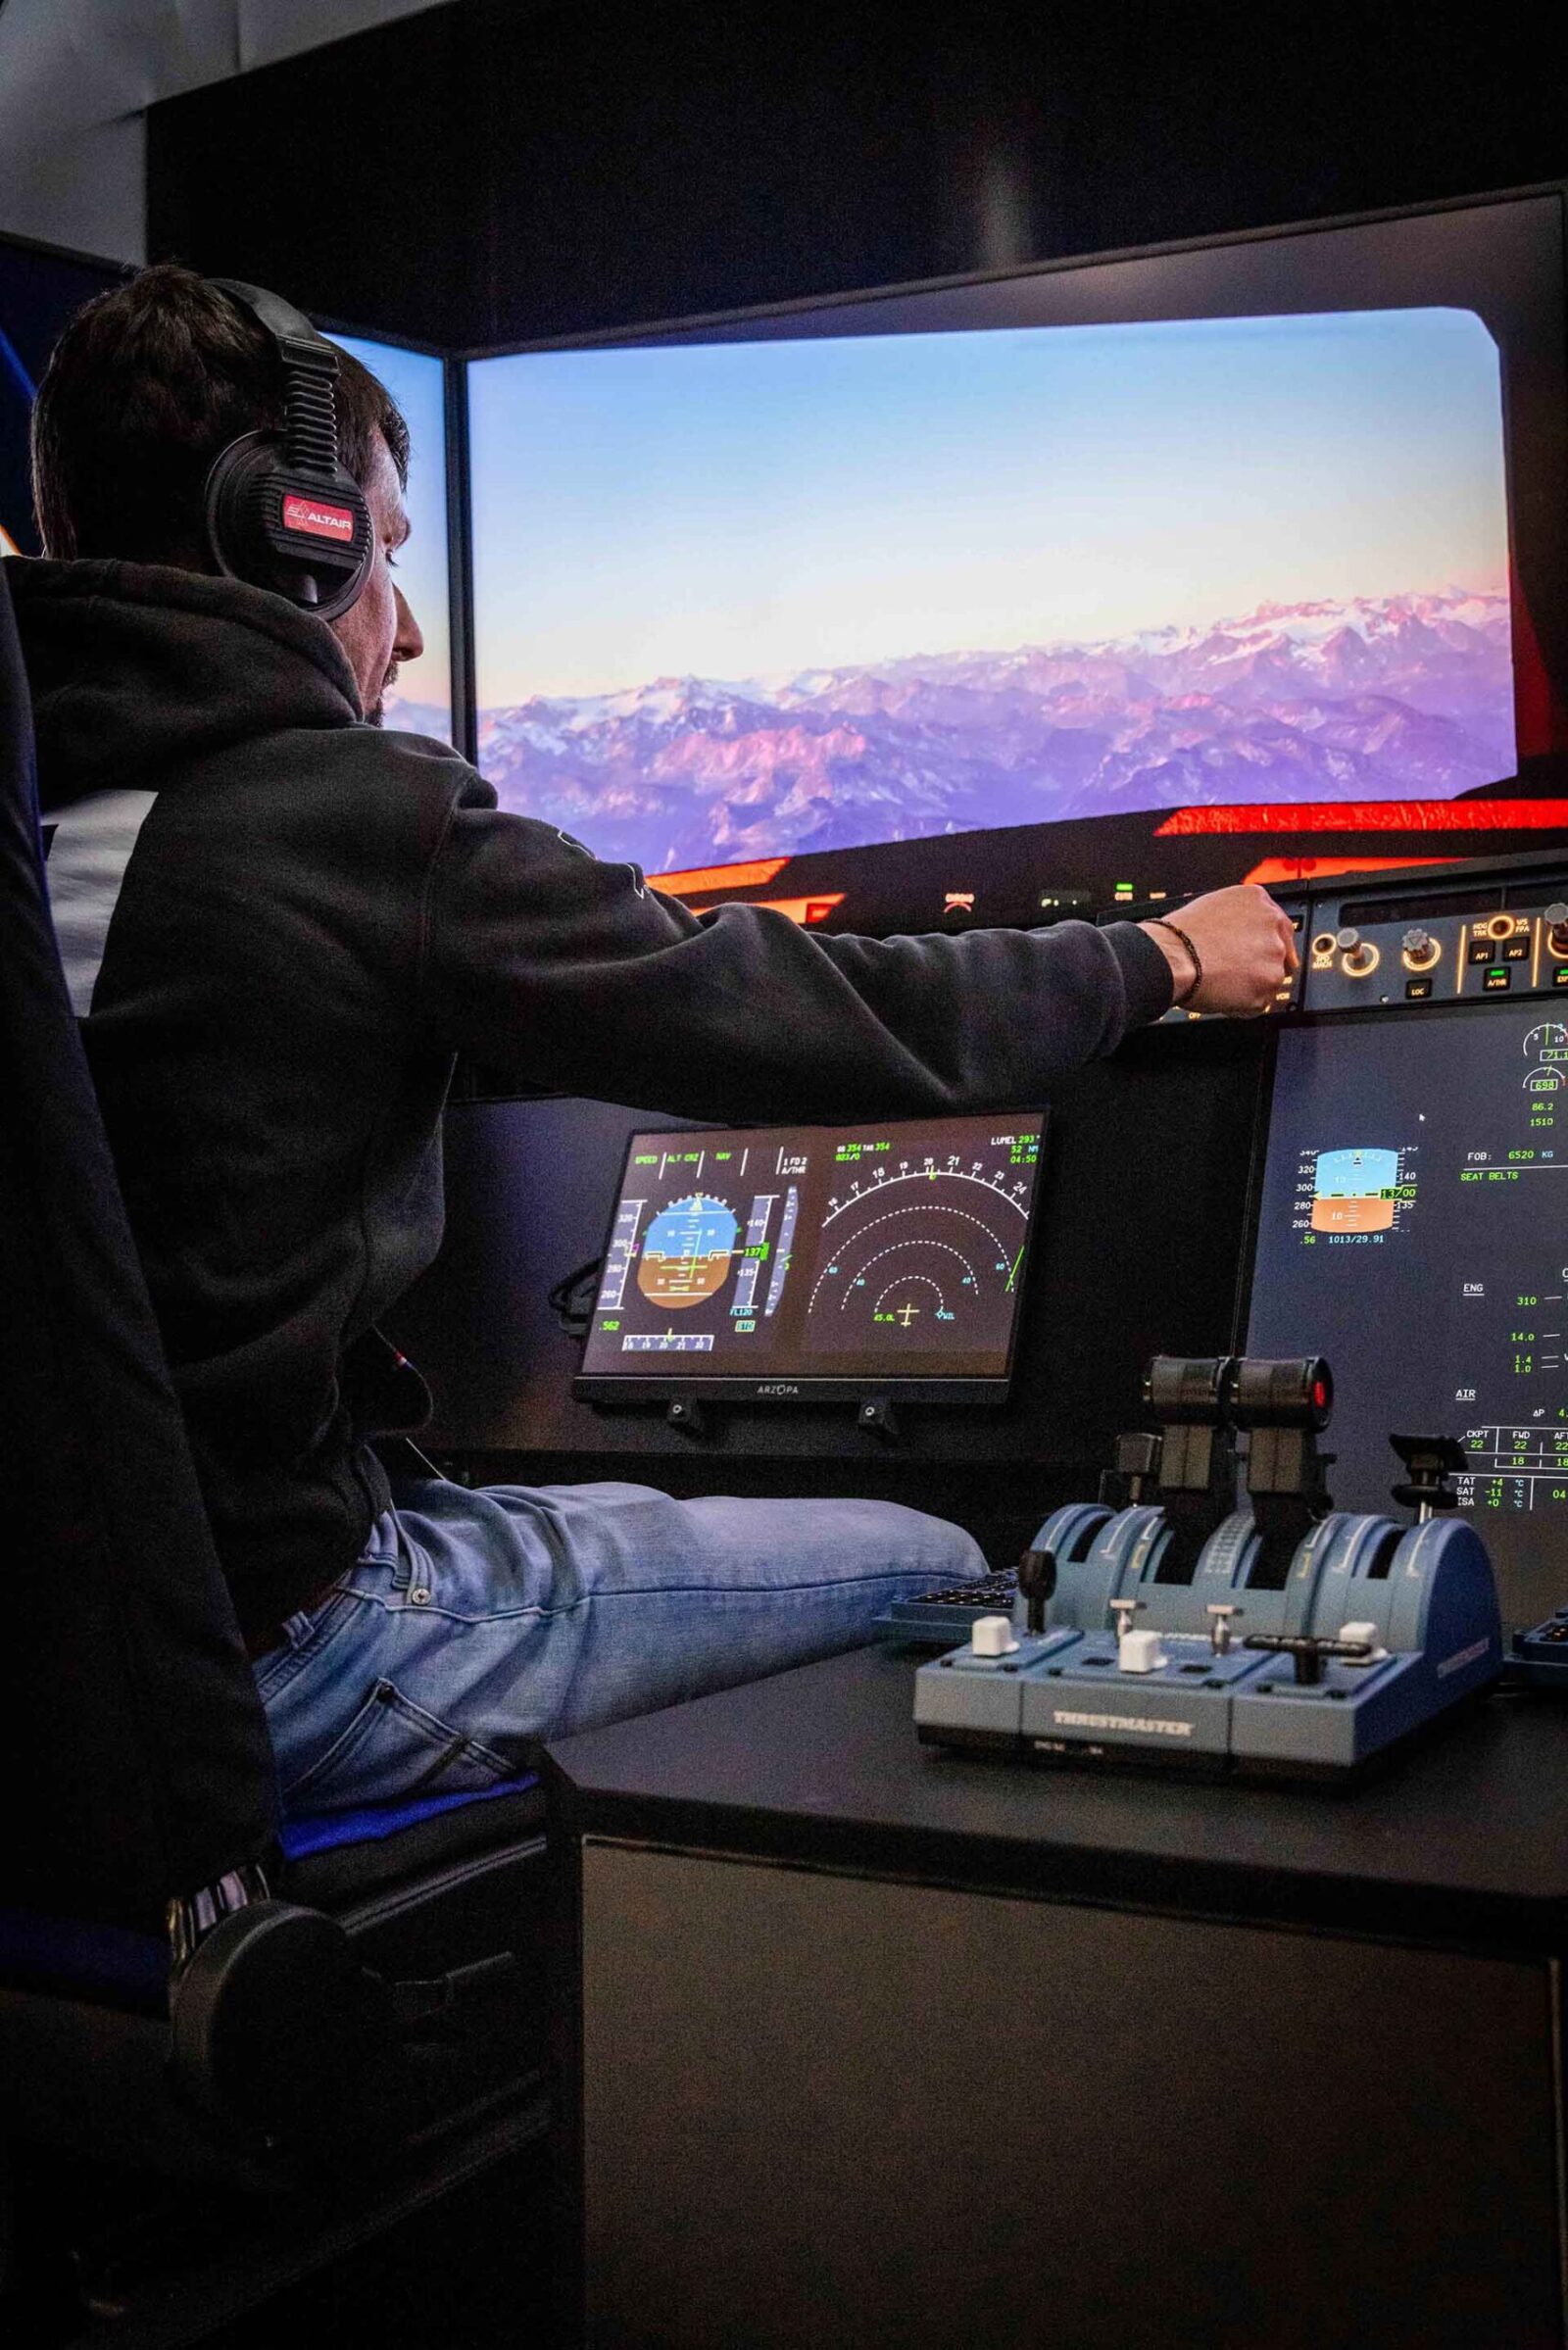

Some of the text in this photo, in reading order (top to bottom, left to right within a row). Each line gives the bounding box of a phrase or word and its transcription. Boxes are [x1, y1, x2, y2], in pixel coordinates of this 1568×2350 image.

[308, 513, 352, 529] ALTAIR
[1475, 952, 1489, 960] AP1
[1508, 949, 1523, 957] AP2
[1411, 987, 1425, 996] LOC
[1554, 1035, 1564, 1044] 10
[1535, 1081, 1554, 1090] 698
[1532, 1102, 1553, 1111] 86.2
[1530, 1117, 1553, 1126] 1510
[1011, 1145, 1022, 1153] 52
[666, 1154, 681, 1163] ALT
[947, 1154, 960, 1166] 21
[1009, 1154, 1037, 1164] 04:50
[1467, 1150, 1554, 1161] FOB: 6520 KG
[802, 1156, 808, 1165] 2
[872, 1166, 886, 1179] 18
[1399, 1172, 1416, 1181] 140
[1460, 1171, 1519, 1182] SEAT BELTS
[1012, 1181, 1028, 1195] 24
[1296, 1183, 1313, 1192] 300
[1294, 1201, 1311, 1210] 280
[1292, 1219, 1310, 1228] 260
[1328, 1234, 1384, 1244] 1013/29.91
[745, 1247, 761, 1257] 137
[1463, 1283, 1484, 1293] ENG
[1516, 1296, 1537, 1305] 310
[1511, 1332, 1535, 1342] 14.0
[1515, 1354, 1532, 1364] 1.4
[1514, 1363, 1532, 1373] 1.0
[1455, 1389, 1476, 1398] AIR
[1466, 1430, 1490, 1439] CKPT
[1512, 1431, 1530, 1440] FWD
[1470, 1440, 1484, 1448] 22
[1513, 1441, 1527, 1450] 22
[1555, 1442, 1568, 1450] 22
[1512, 1456, 1525, 1466] 18
[1457, 1477, 1476, 1486] TAT
[1492, 1478, 1503, 1487] +4
[1456, 1487, 1475, 1495] SAT
[1485, 1488, 1502, 1497] -11
[1552, 1490, 1566, 1499] 04
[1457, 1497, 1475, 1507] ISA
[1488, 1498, 1499, 1507] +0
[1053, 1710, 1194, 1738] THRUSTMASTER
